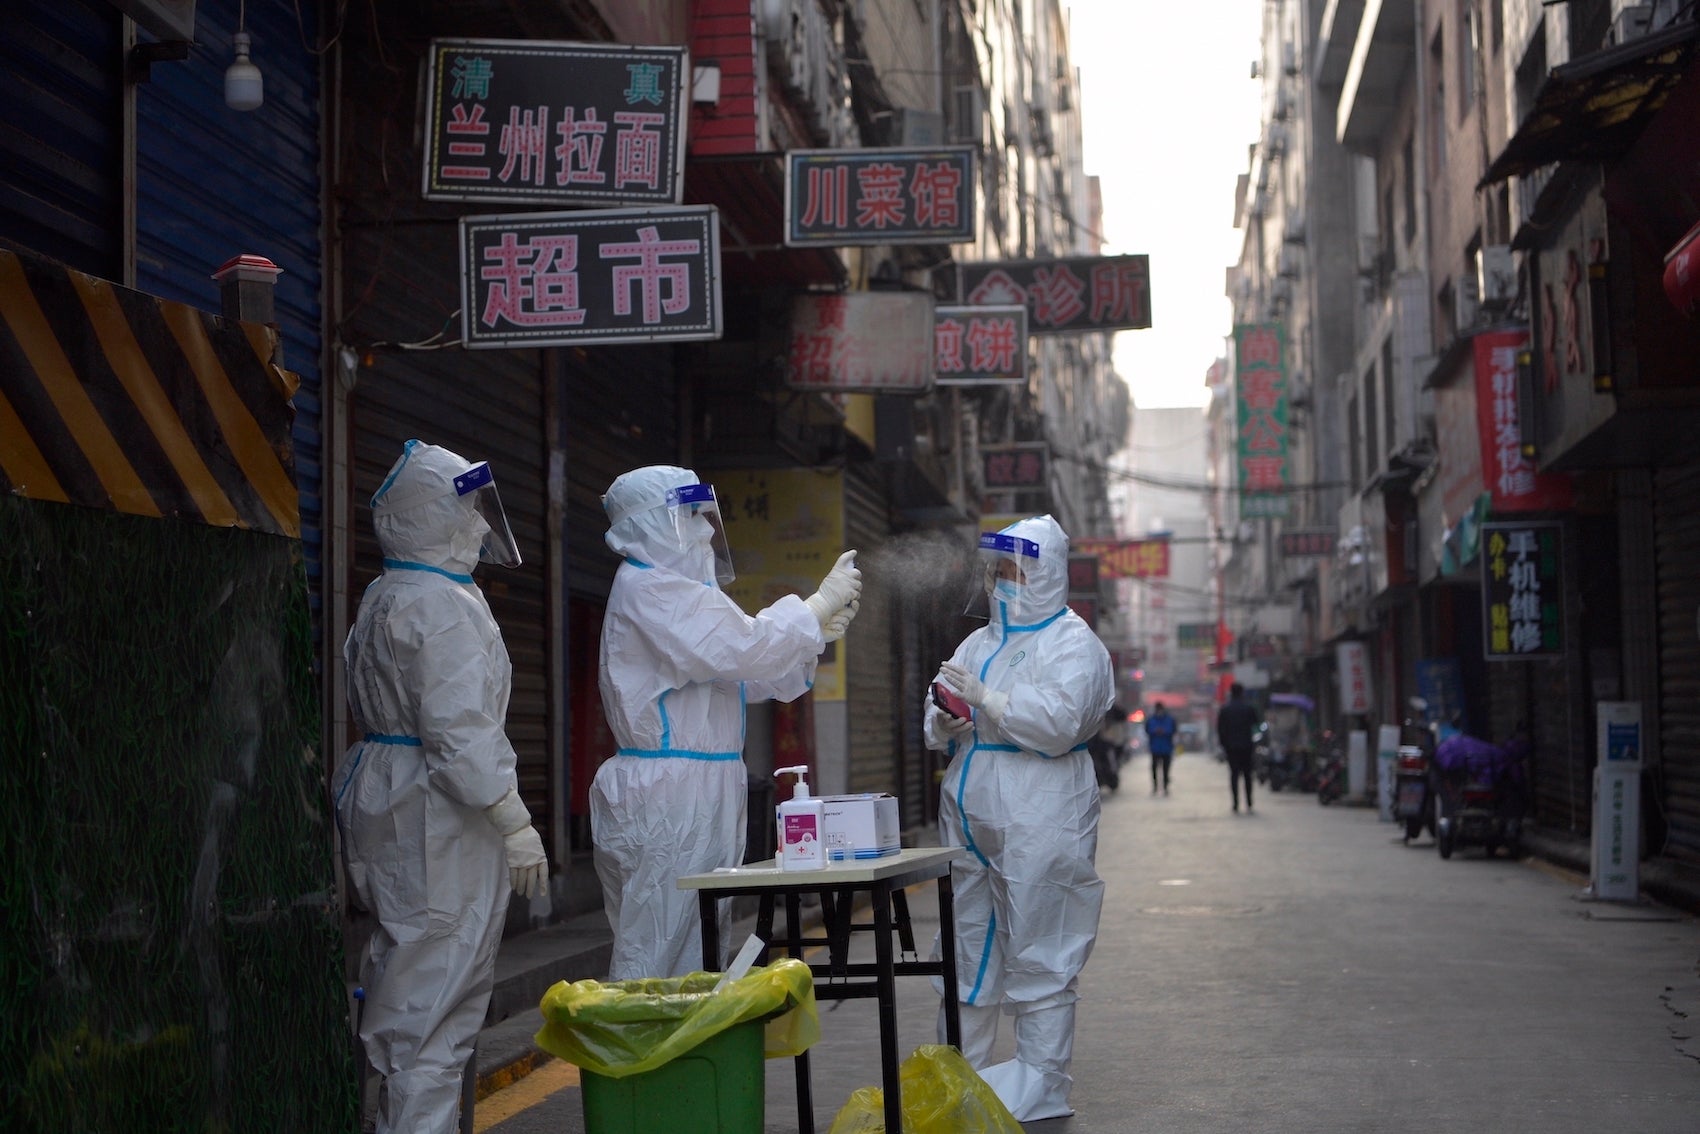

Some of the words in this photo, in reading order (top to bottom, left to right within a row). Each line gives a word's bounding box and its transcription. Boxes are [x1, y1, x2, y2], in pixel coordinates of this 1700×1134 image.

[451, 56, 494, 100] 清
[623, 62, 665, 105] 真
[441, 103, 665, 190] 兰州拉面
[801, 162, 962, 229] 川菜馆
[480, 226, 701, 328] 超市
[1028, 261, 1146, 327] 诊所
[1506, 529, 1542, 653] 手机维修
